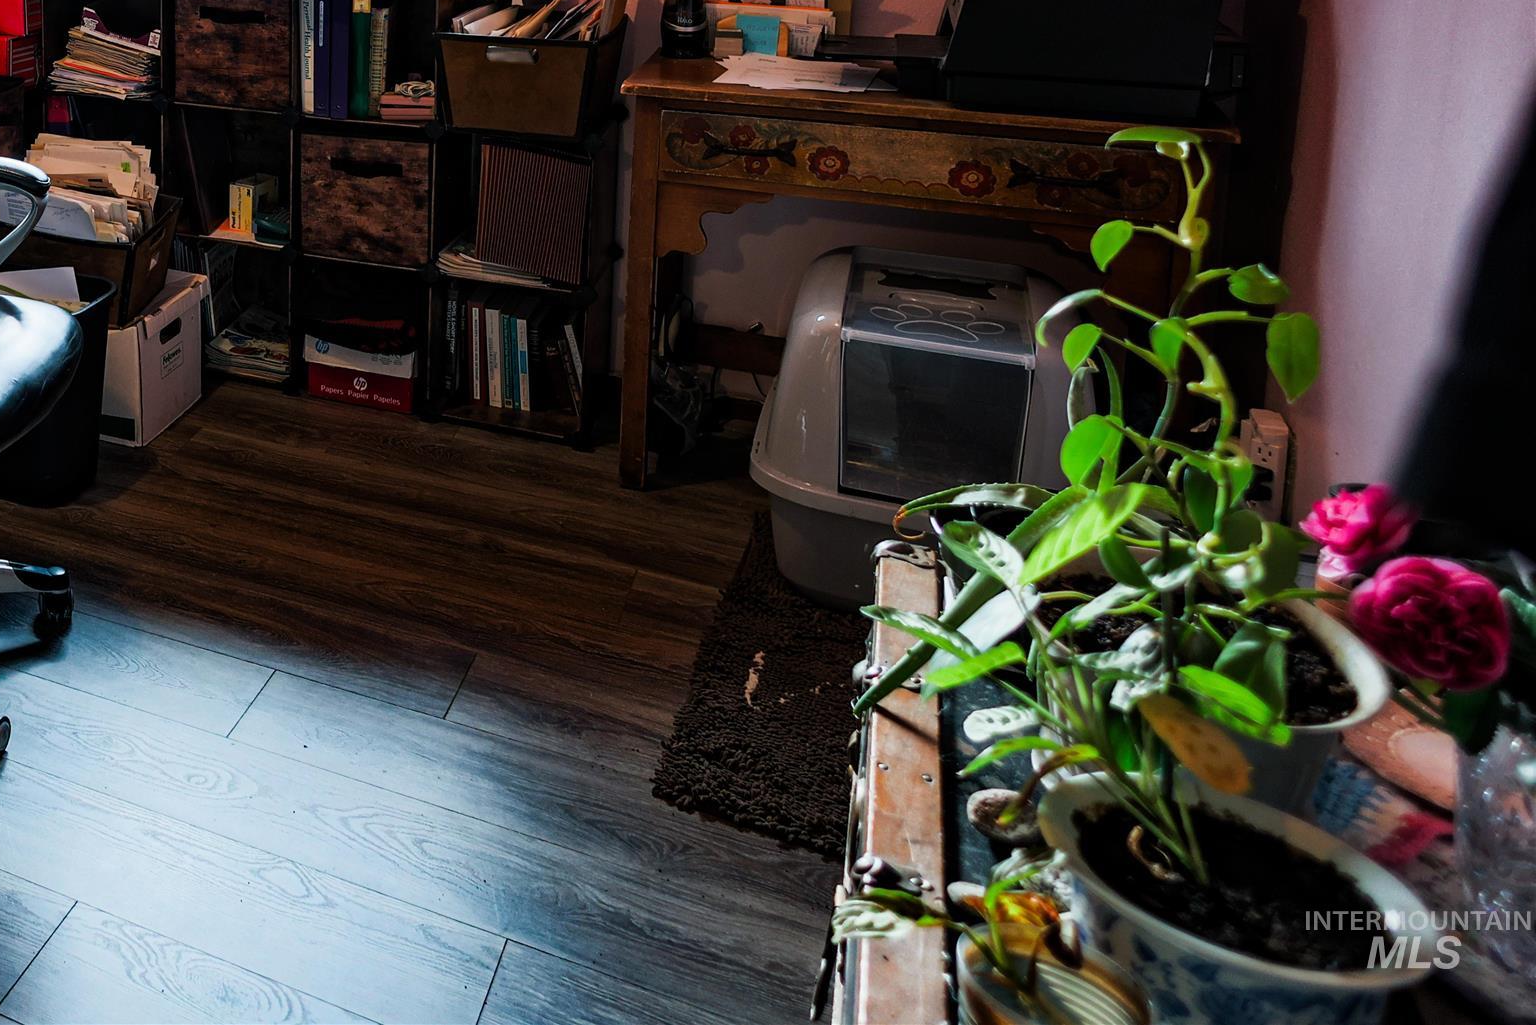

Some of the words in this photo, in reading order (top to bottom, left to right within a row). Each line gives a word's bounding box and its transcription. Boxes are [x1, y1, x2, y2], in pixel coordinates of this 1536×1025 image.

[303, 0, 313, 31] Personal
[304, 31, 312, 53] Health
[304, 54, 312, 80] Journal
[316, 339, 329, 353] hp
[353, 376, 368, 391] hp
[320, 384, 344, 395] Papers
[348, 389, 369, 400] Papier
[373, 394, 401, 406] Papeles
